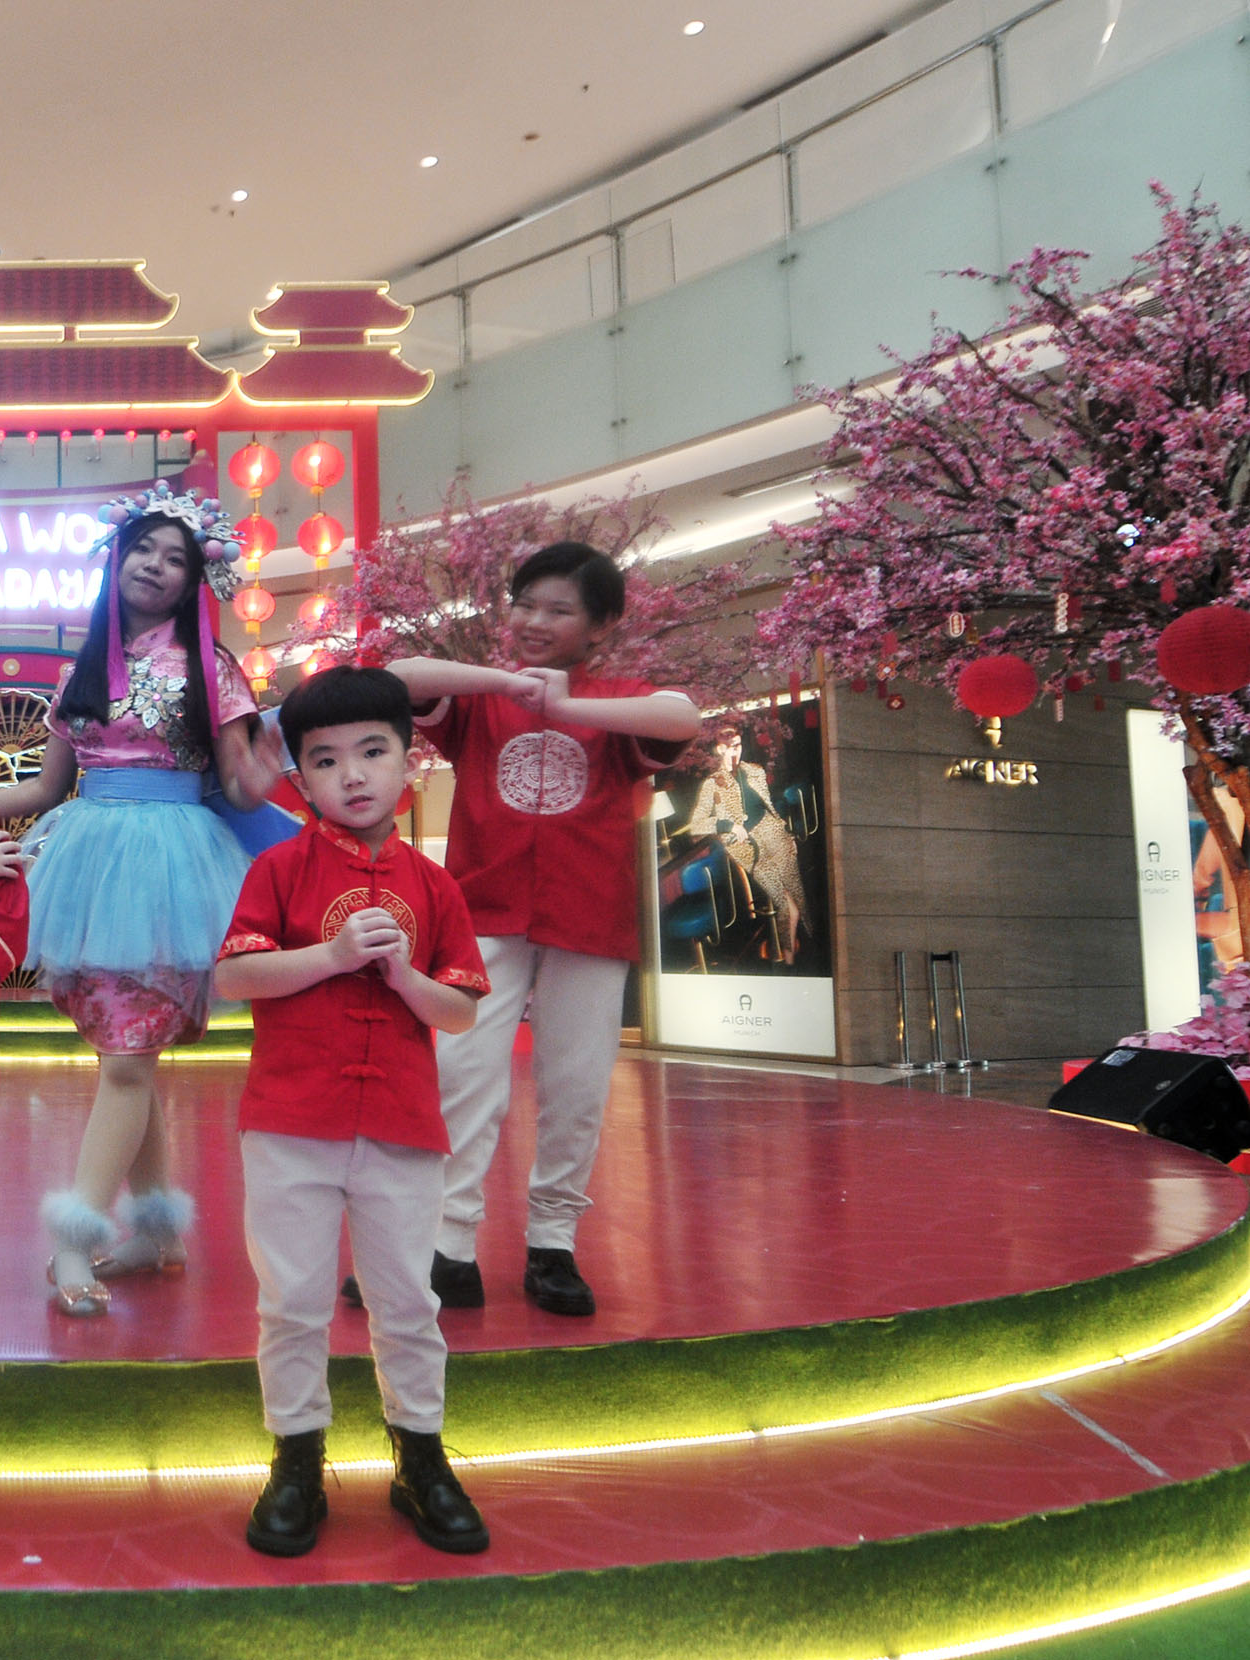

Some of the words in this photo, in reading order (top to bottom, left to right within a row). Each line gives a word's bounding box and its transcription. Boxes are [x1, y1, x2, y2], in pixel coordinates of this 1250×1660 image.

[944, 759, 1039, 785] AIGNER
[1140, 868, 1181, 881] IGNER
[722, 1015, 773, 1027] AIGNER
